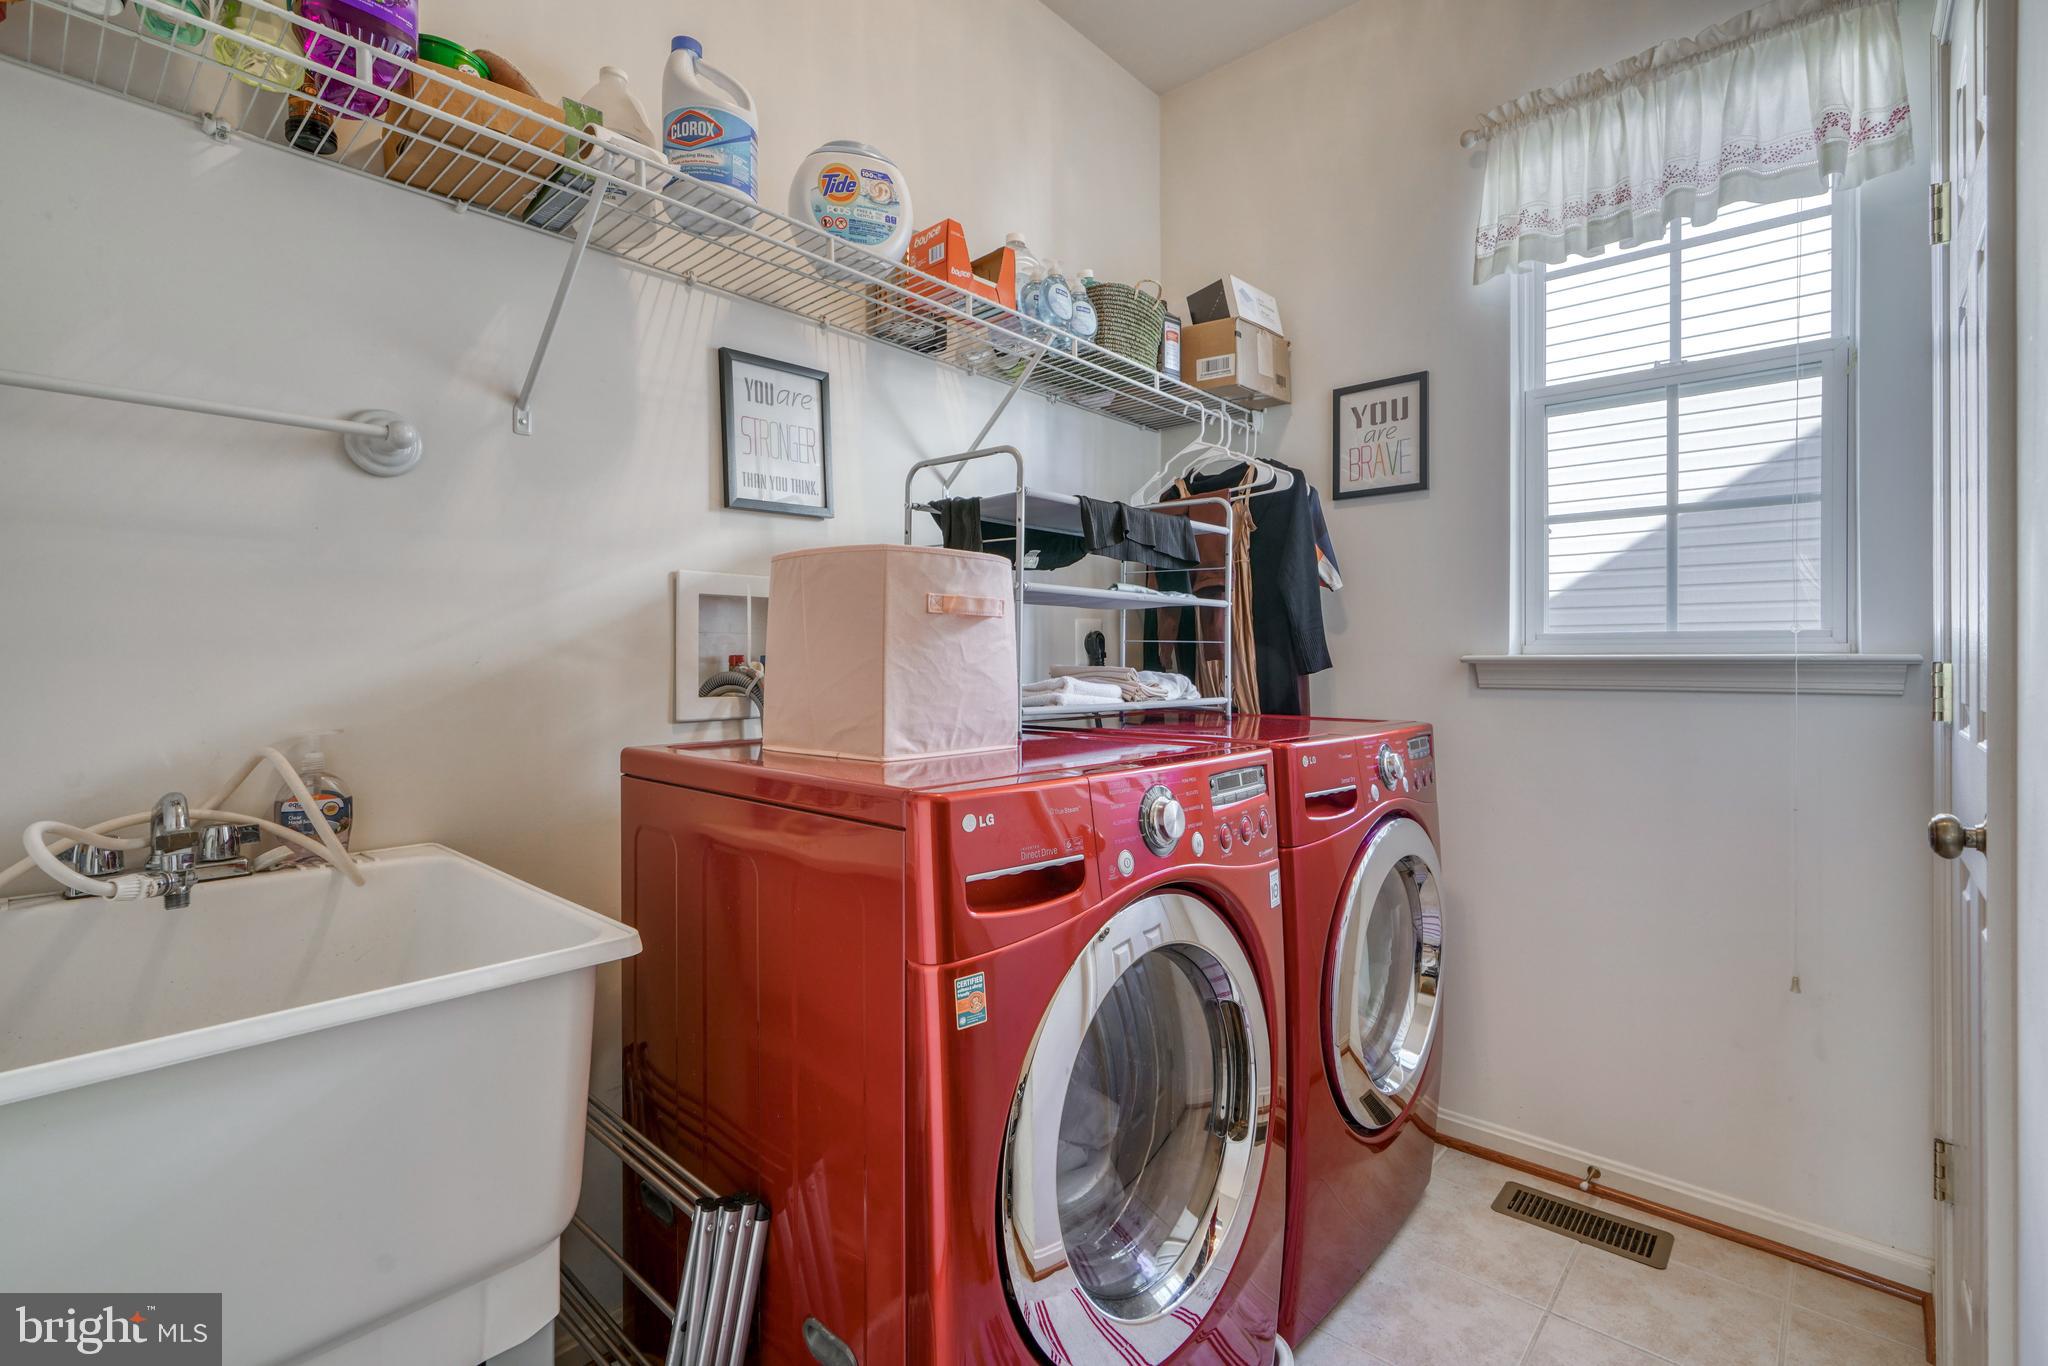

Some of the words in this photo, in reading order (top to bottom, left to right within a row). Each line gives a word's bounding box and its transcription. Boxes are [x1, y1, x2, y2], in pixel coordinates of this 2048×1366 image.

[671, 121, 715, 140] CLOROX
[822, 173, 857, 197] Tide
[744, 377, 774, 406] YOU
[777, 389, 814, 410] are
[1351, 396, 1409, 429] YOU
[741, 415, 816, 464] STRONGER
[1364, 426, 1398, 443] are
[1349, 437, 1411, 482] BRAVE
[742, 471, 767, 490] THAN
[770, 475, 788, 492] YOU
[791, 478, 820, 496] THINK.
[979, 813, 995, 828] LG
[1021, 850, 1040, 860] Direct
[1041, 847, 1058, 857] Drive
[957, 975, 983, 989] CERTIFIED
